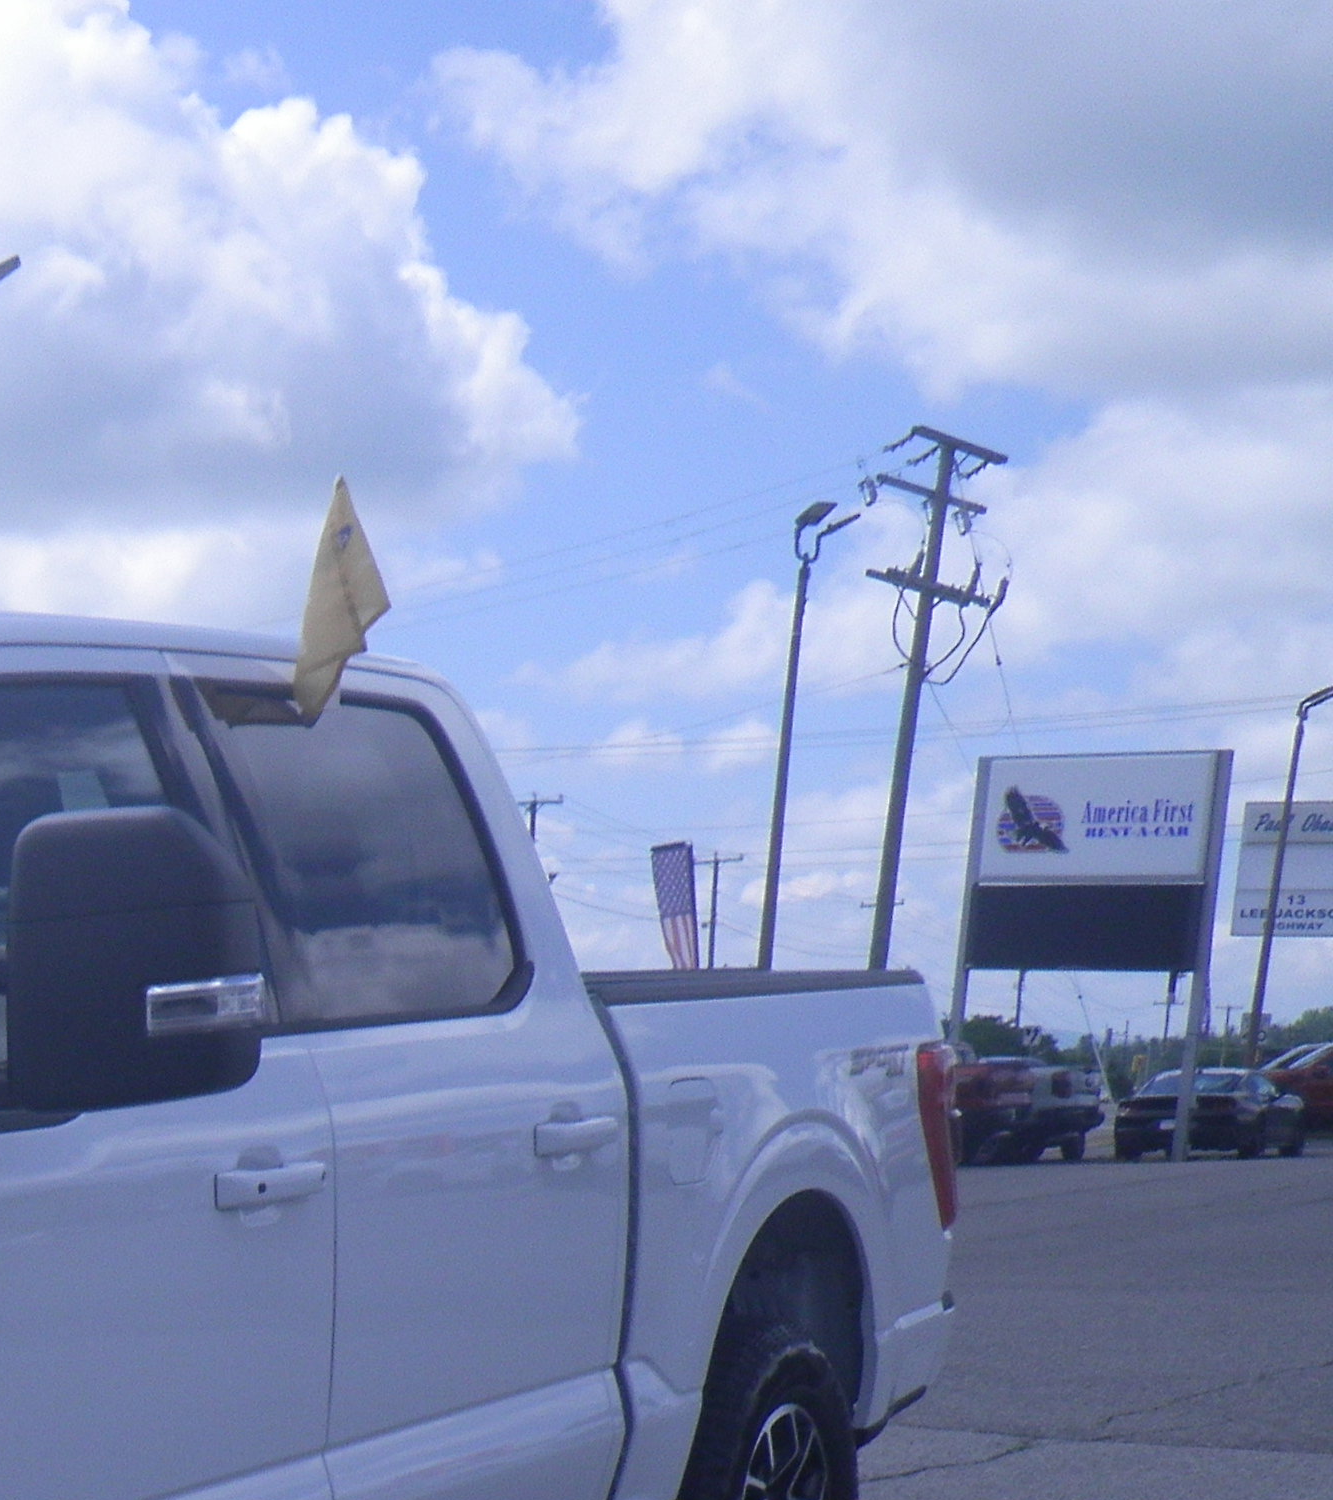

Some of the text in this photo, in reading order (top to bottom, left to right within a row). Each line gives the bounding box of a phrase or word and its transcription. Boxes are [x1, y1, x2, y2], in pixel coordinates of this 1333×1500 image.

[1081, 798, 1194, 824] America First
[1287, 894, 1306, 906] 13
